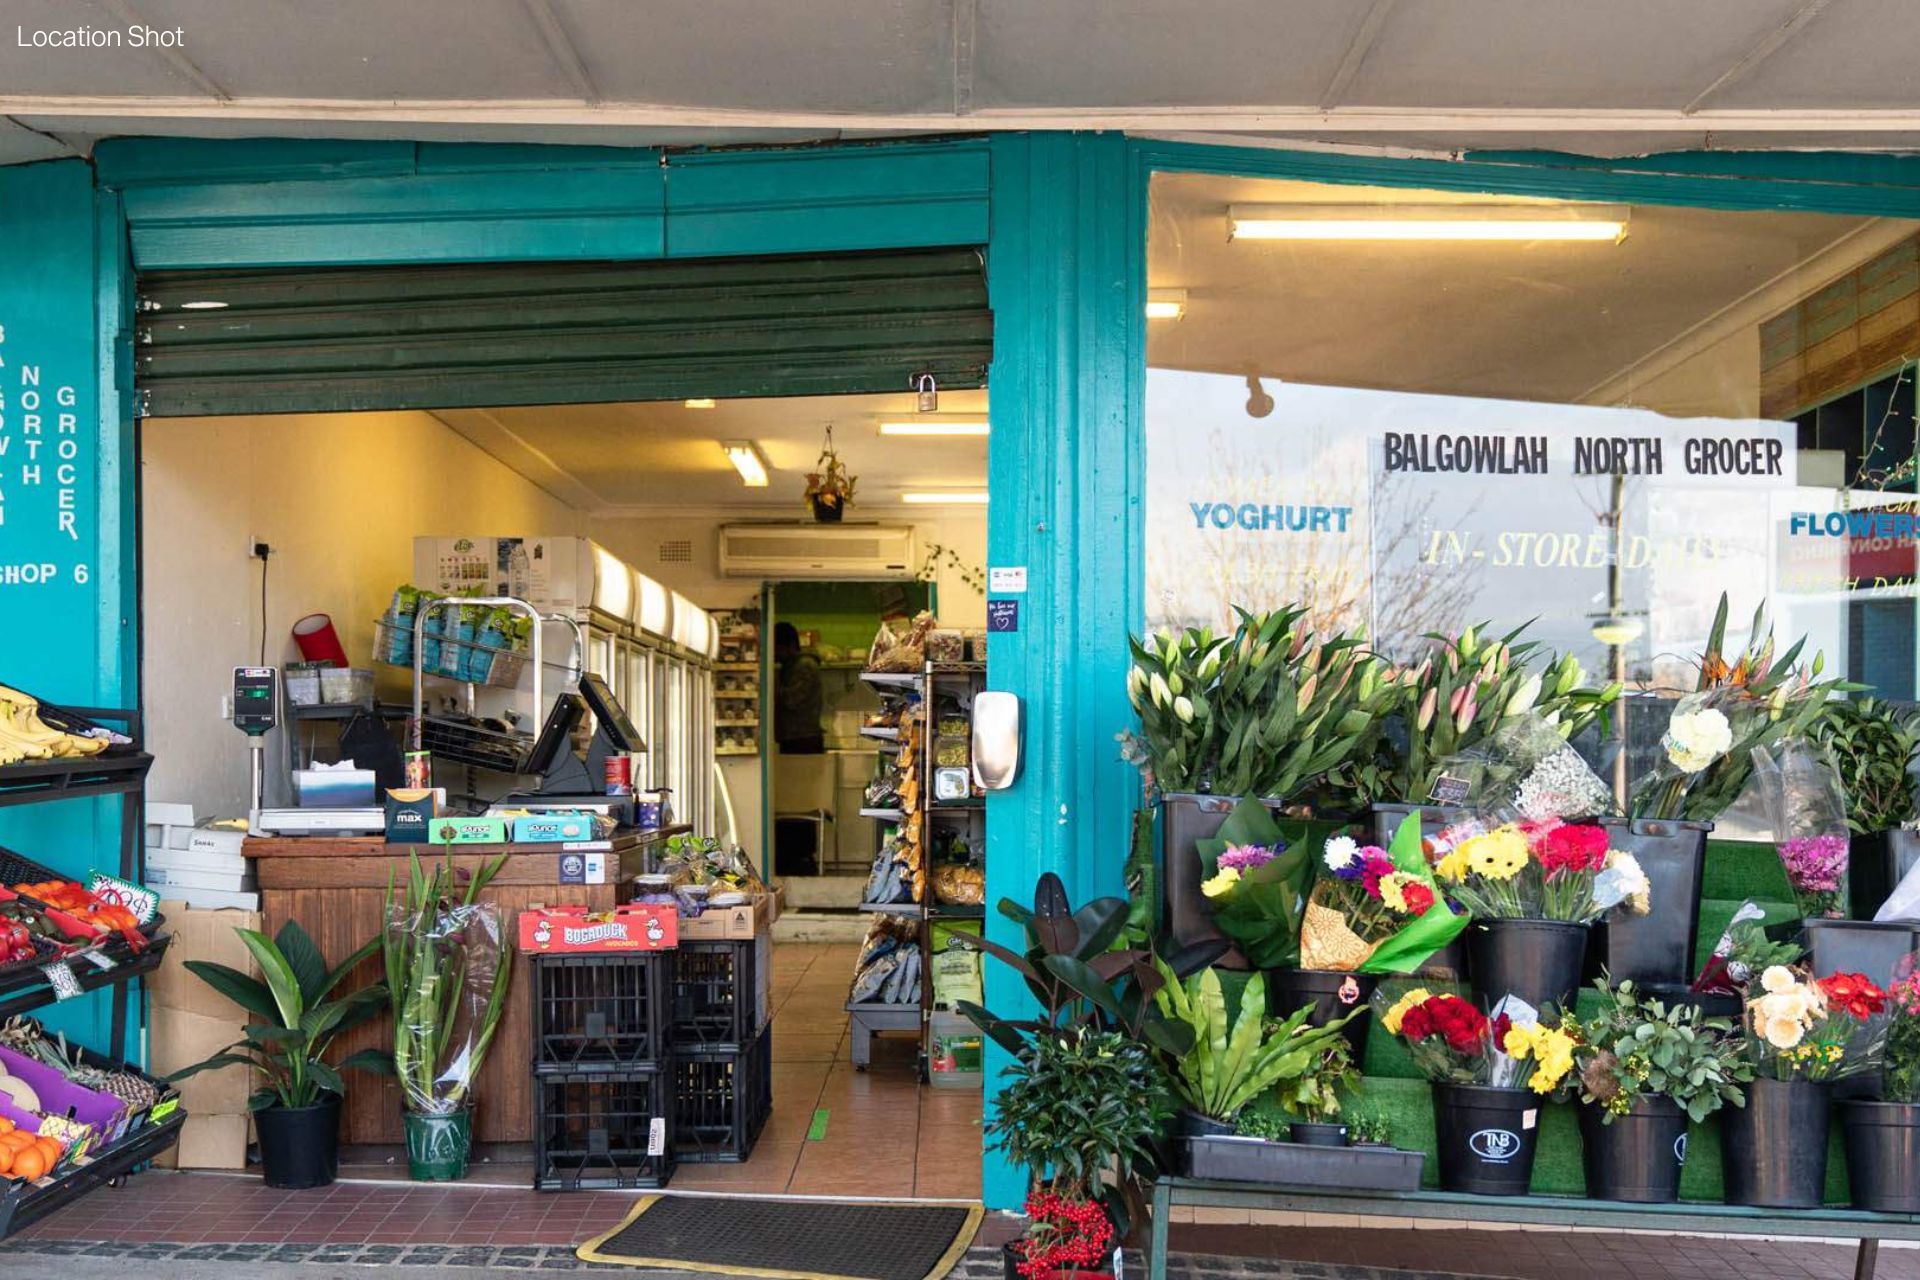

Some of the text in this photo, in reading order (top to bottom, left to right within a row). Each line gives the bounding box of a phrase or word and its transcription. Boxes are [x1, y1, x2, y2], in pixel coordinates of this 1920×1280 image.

[21, 365, 43, 486] NORTH
[57, 386, 79, 541] GROCER
[1385, 432, 1783, 476] BALGOWLAH NORTH GROCER
[1190, 502, 1353, 533] YOGHURT
[1791, 512, 1920, 538] FLOWER
[0, 563, 89, 584] HOP 6
[396, 814, 422, 823] max
[564, 922, 628, 946] BOGADUCK
[1483, 1132, 1509, 1147] TNB
